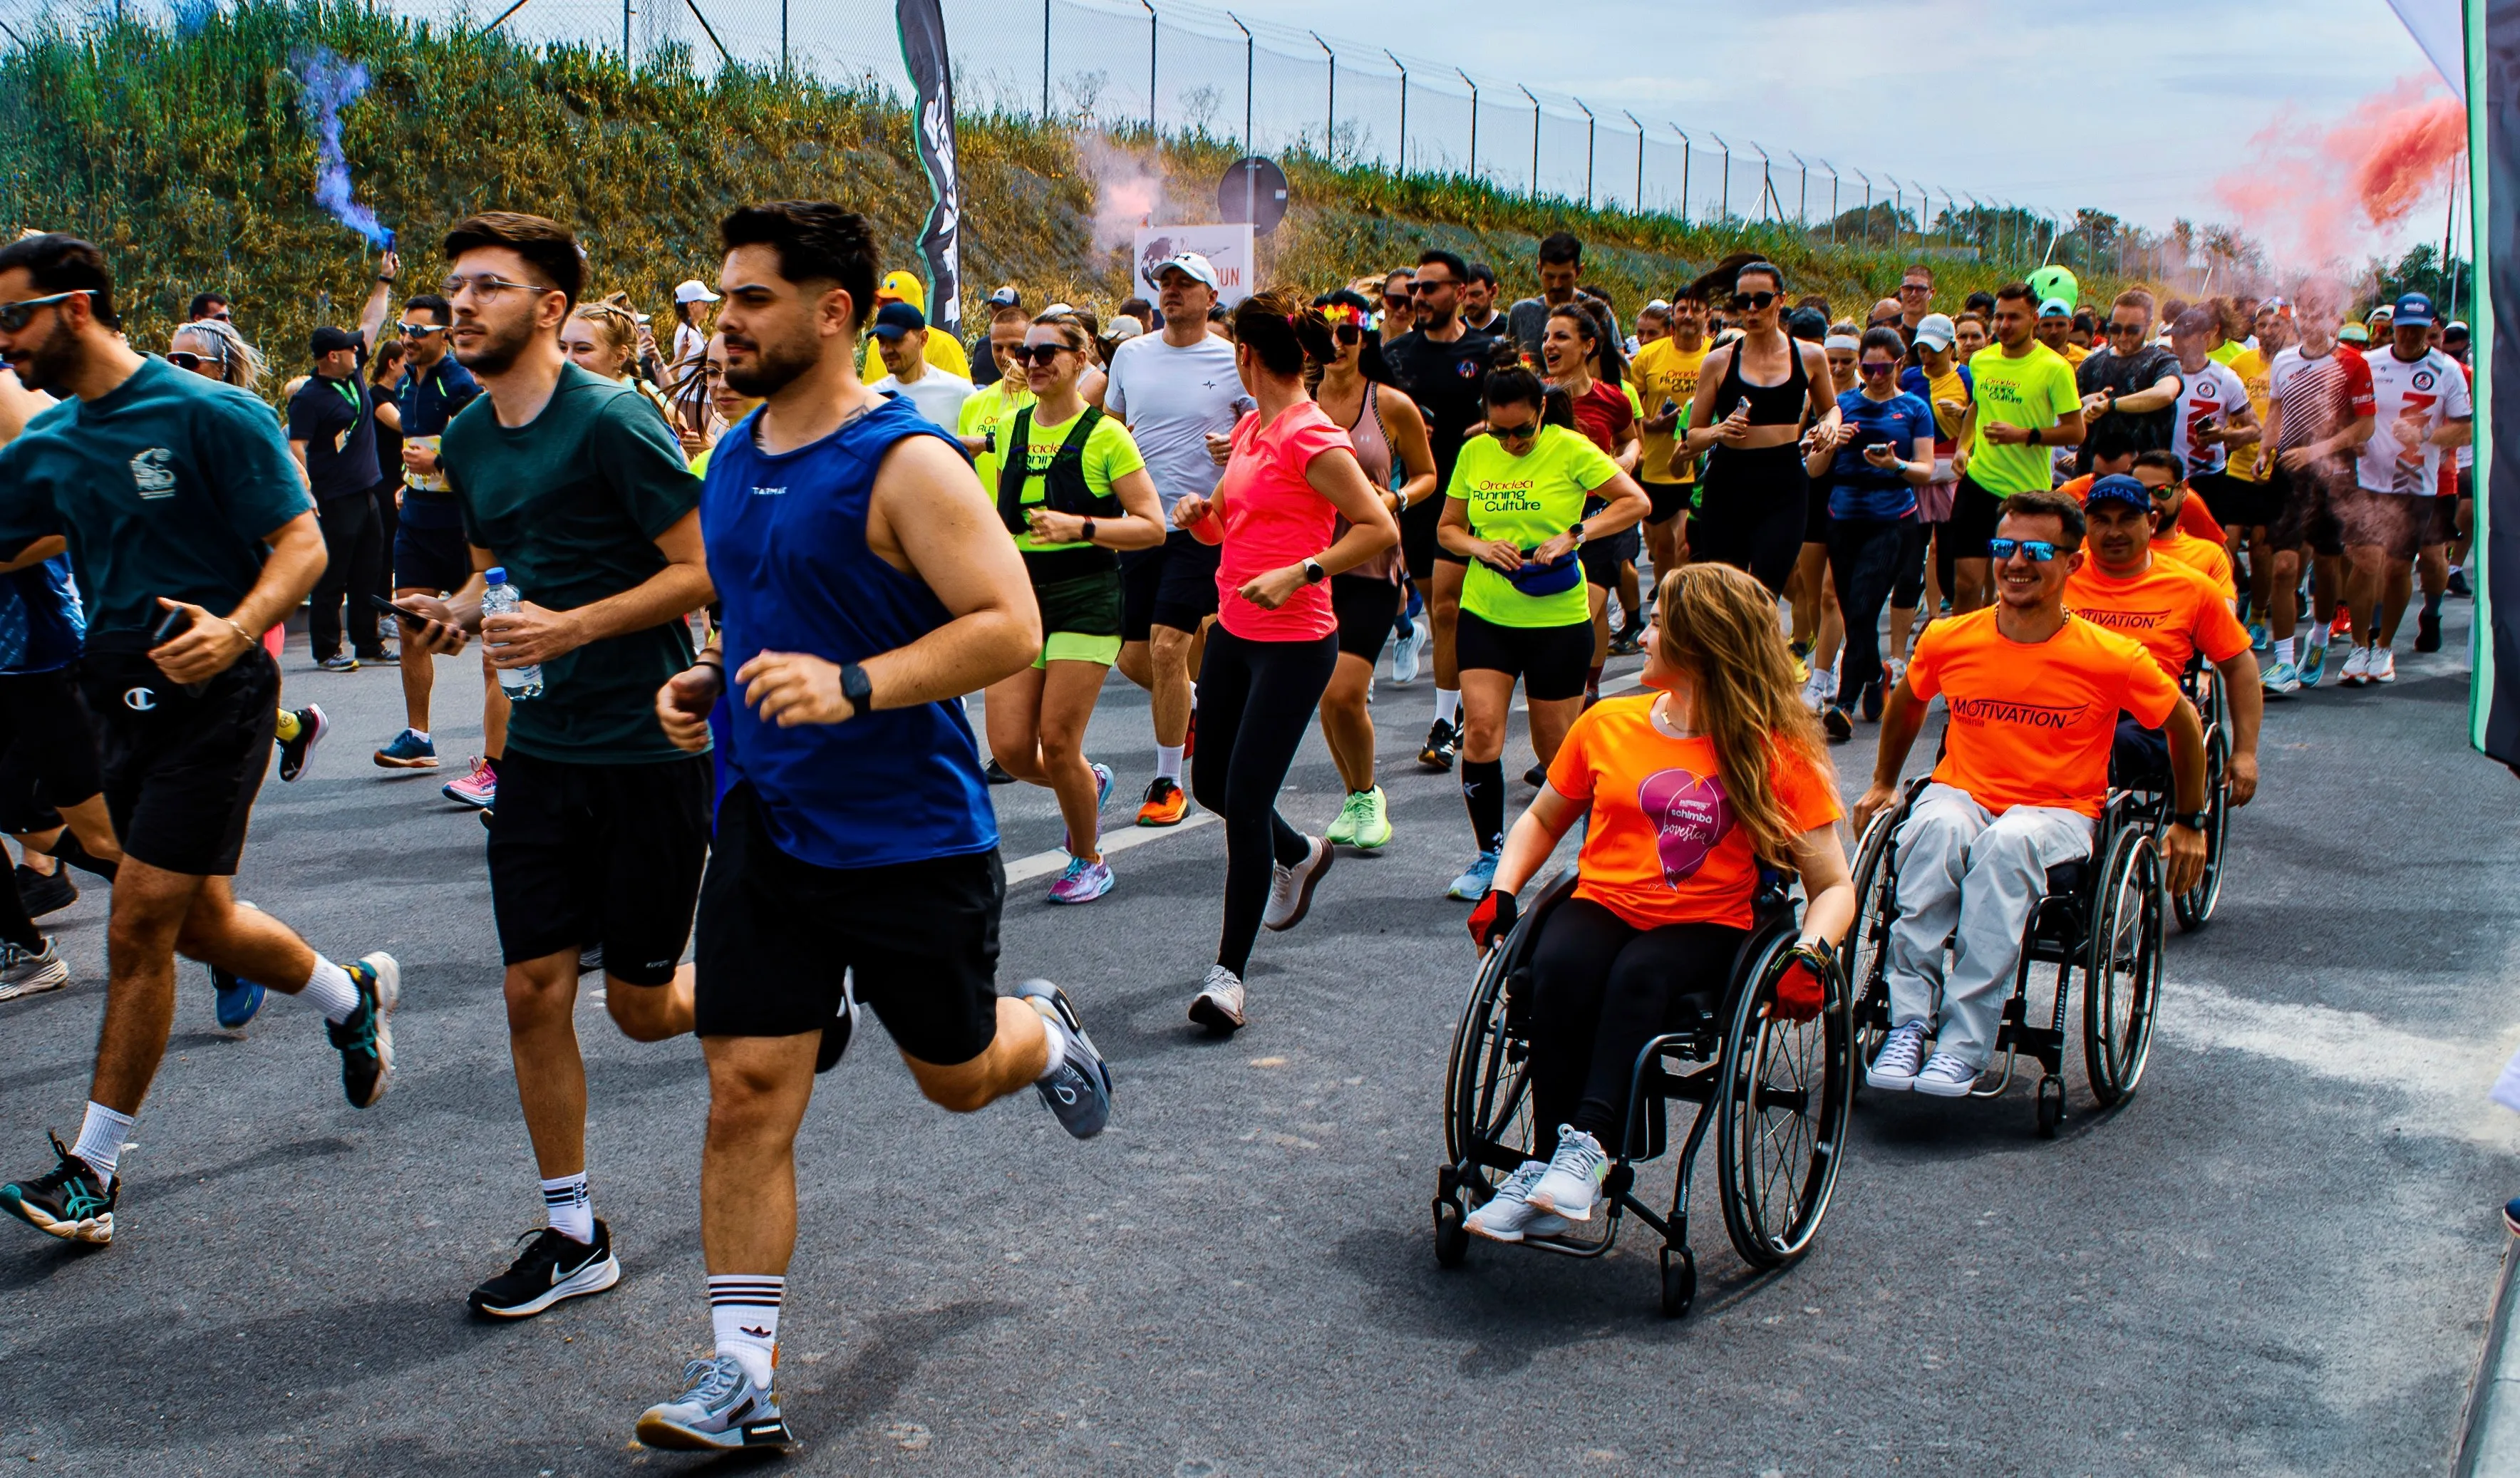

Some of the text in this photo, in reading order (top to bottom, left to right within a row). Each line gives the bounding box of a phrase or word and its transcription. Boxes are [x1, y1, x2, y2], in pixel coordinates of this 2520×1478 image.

[1480, 480, 1534, 491] Oradea
[1473, 490, 1527, 501] Running
[1484, 499, 1541, 512] Culture
[1953, 698, 2067, 728] MOTIVATION
[1671, 808, 1713, 825] schimba
